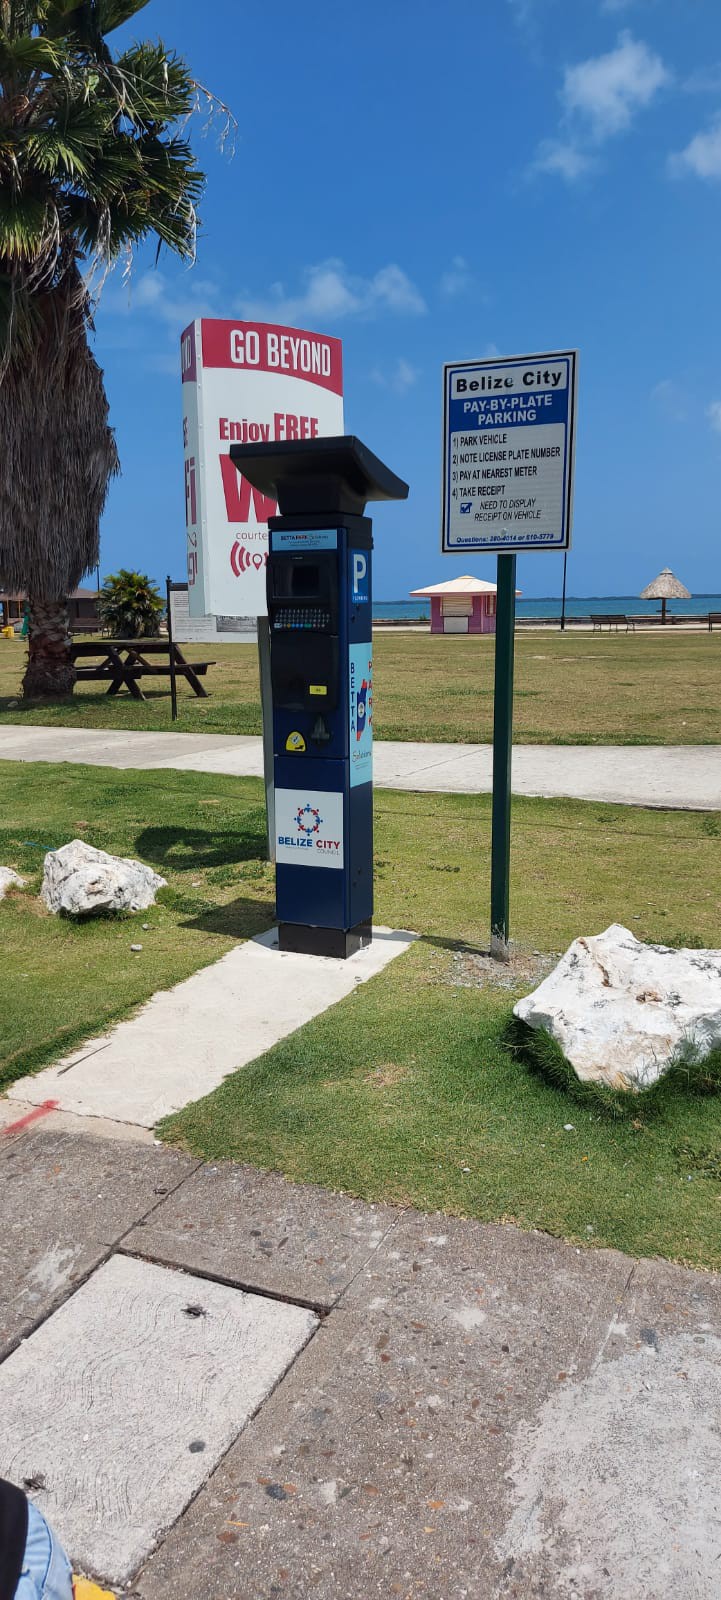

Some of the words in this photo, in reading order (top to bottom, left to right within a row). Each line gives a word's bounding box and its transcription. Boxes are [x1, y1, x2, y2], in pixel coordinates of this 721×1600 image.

[230, 329, 260, 365] GO
[267, 333, 331, 377] BEYOND
[456, 376, 514, 393] Belize
[522, 370, 562, 387] City
[463, 394, 553, 413] PAY-BY-PLATE
[478, 409, 537, 425] PARKING
[219, 417, 270, 443] Enjoy
[273, 412, 319, 441] FREE
[460, 436, 478, 447] PARK
[479, 433, 507, 445] VEHICLE
[460, 453, 478, 464] NOTE
[479, 450, 507, 462] LICENSE
[508, 448, 530, 460] PLATE
[530, 446, 561, 459] NUMBER
[460, 470, 472, 481] PAY
[472, 470, 481, 480] AT
[481, 467, 513, 479] NEAREST
[514, 465, 538, 477] METER
[460, 486, 476, 498] TAKE
[477, 484, 506, 496] RECEIPT
[479, 500, 499, 511] NEED
[500, 500, 508, 509] TO
[508, 497, 537, 508] DISPLAY
[474, 511, 502, 522] RECEIPT
[502, 511, 512, 520] ON
[513, 509, 542, 520] VEHICLE
[353, 553, 367, 594] P
[278, 836, 313, 847] BELIZE
[315, 839, 341, 850] CITY
